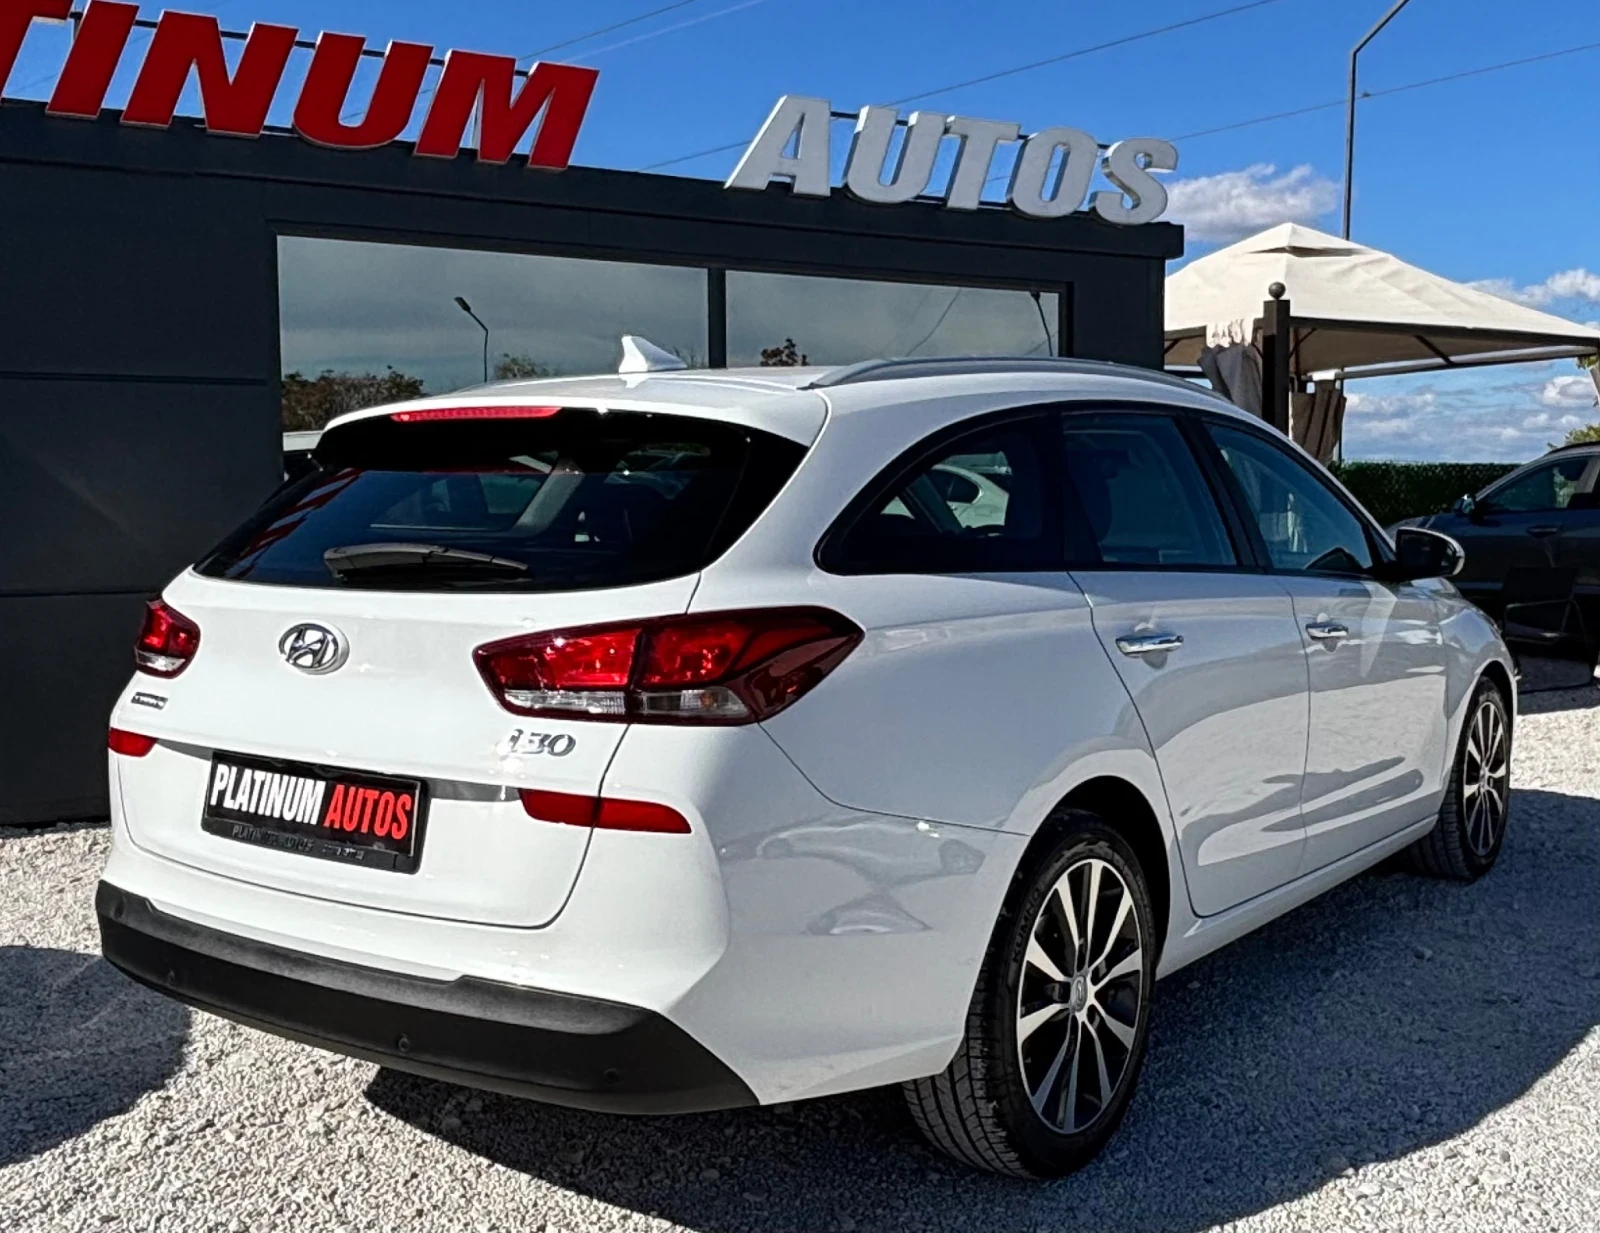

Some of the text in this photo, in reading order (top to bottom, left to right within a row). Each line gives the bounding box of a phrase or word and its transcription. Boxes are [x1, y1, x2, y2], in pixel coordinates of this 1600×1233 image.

[723, 95, 1178, 225] AUTOS
[209, 763, 412, 841] PLATINUM AUTOS
